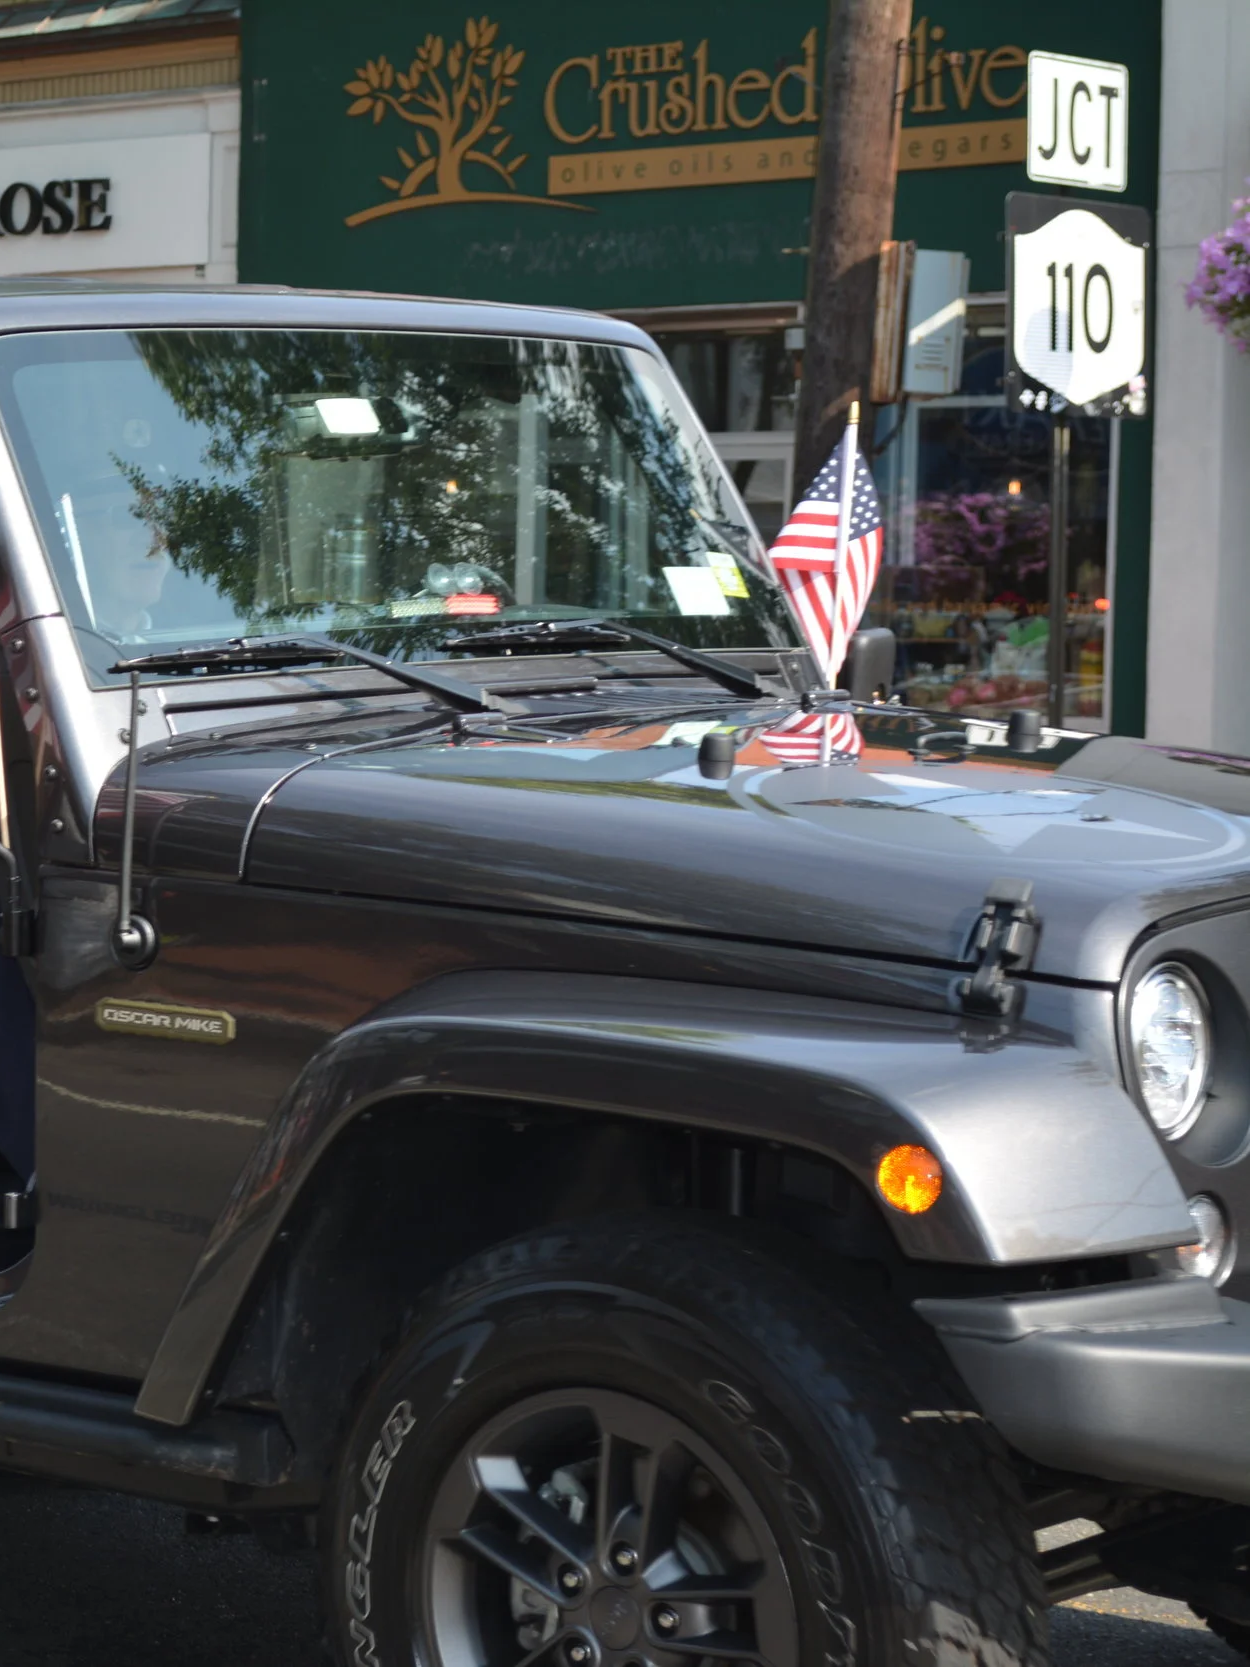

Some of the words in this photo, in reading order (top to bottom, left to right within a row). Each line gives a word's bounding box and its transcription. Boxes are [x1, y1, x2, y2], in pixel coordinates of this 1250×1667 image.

[544, 26, 818, 143] Crushed
[902, 17, 1028, 111] live
[607, 41, 683, 75] THE
[1038, 78, 1119, 168] JCT
[561, 159, 647, 184] olive
[668, 150, 733, 176] oils
[1047, 262, 1113, 353] 110
[103, 1008, 171, 1028] OSCAR
[174, 1016, 222, 1034] MIKE
